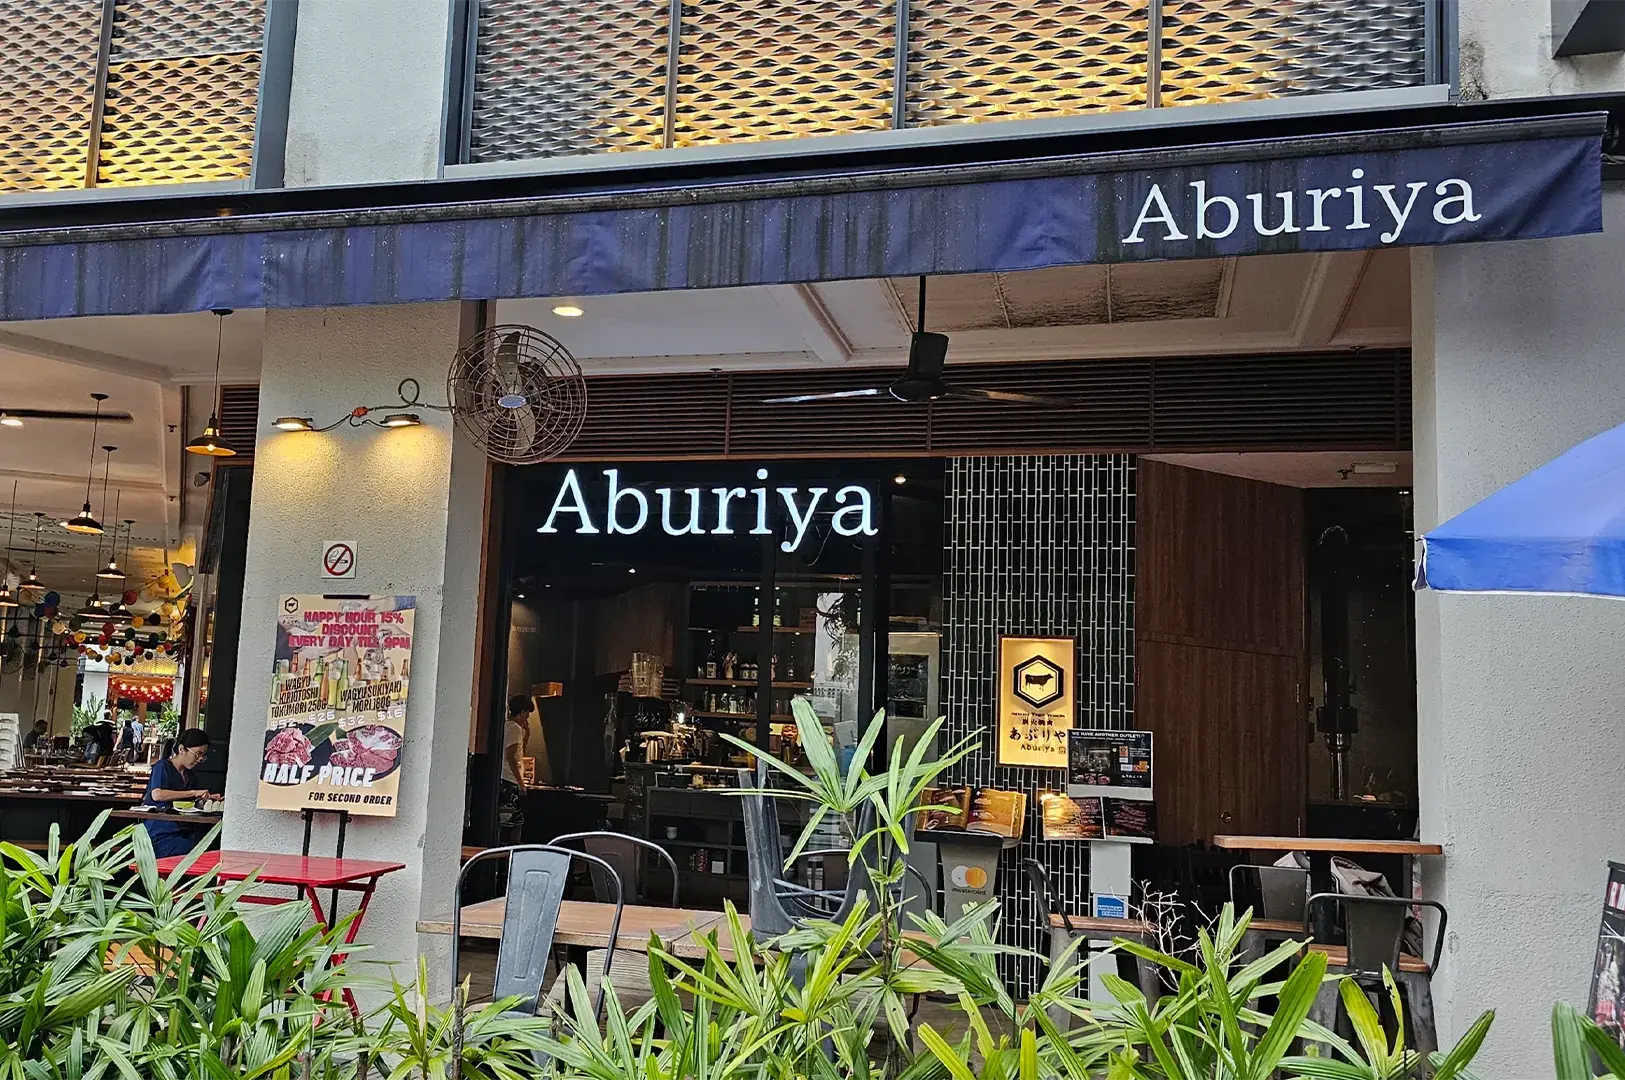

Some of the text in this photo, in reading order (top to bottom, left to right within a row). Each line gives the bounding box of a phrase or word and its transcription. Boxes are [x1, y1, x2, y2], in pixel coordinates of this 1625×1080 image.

[1122, 168, 1481, 244] Aburiya
[536, 468, 878, 553] Aburiya
[304, 611, 341, 622] HAPPY
[345, 611, 376, 623] HOUR
[380, 612, 404, 624] 15%
[321, 623, 379, 635] DISCOUNT
[288, 636, 325, 647] EVERY
[328, 636, 353, 647] DAY
[384, 637, 411, 648] 9PM
[285, 675, 311, 691] WAGYU
[340, 680, 402, 702] WAGYU SUKIYAKI
[271, 698, 328, 718] TOKUMORI 250G
[352, 699, 371, 713] MORI
[308, 711, 335, 724] $26
[338, 709, 403, 729] $32 $16
[1009, 726, 1066, 744] あぶりや
[1020, 744, 1055, 753] Aburiya
[263, 763, 376, 788] HALF PRICE
[308, 792, 392, 806] FOR SECOND ORDER
[952, 887, 986, 896] mastercard
